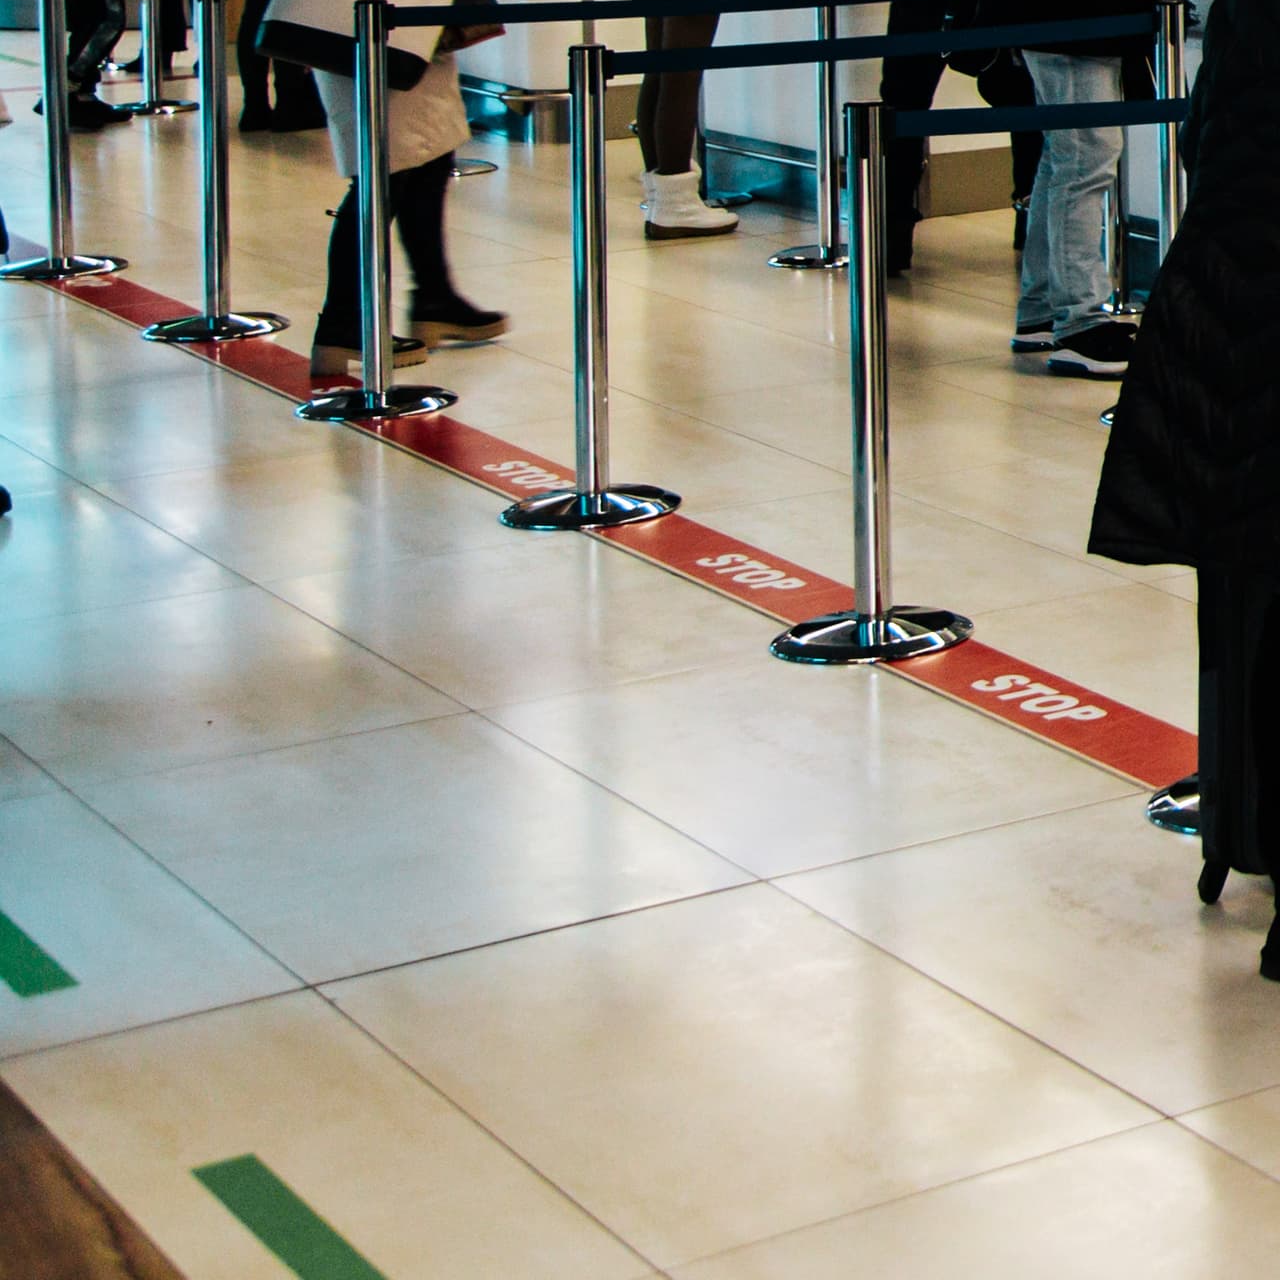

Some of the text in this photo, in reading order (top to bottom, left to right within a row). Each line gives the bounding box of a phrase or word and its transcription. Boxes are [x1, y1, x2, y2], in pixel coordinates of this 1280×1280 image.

[482, 460, 577, 489] STOP
[695, 553, 807, 593] STOP
[972, 674, 1108, 723] STOP
